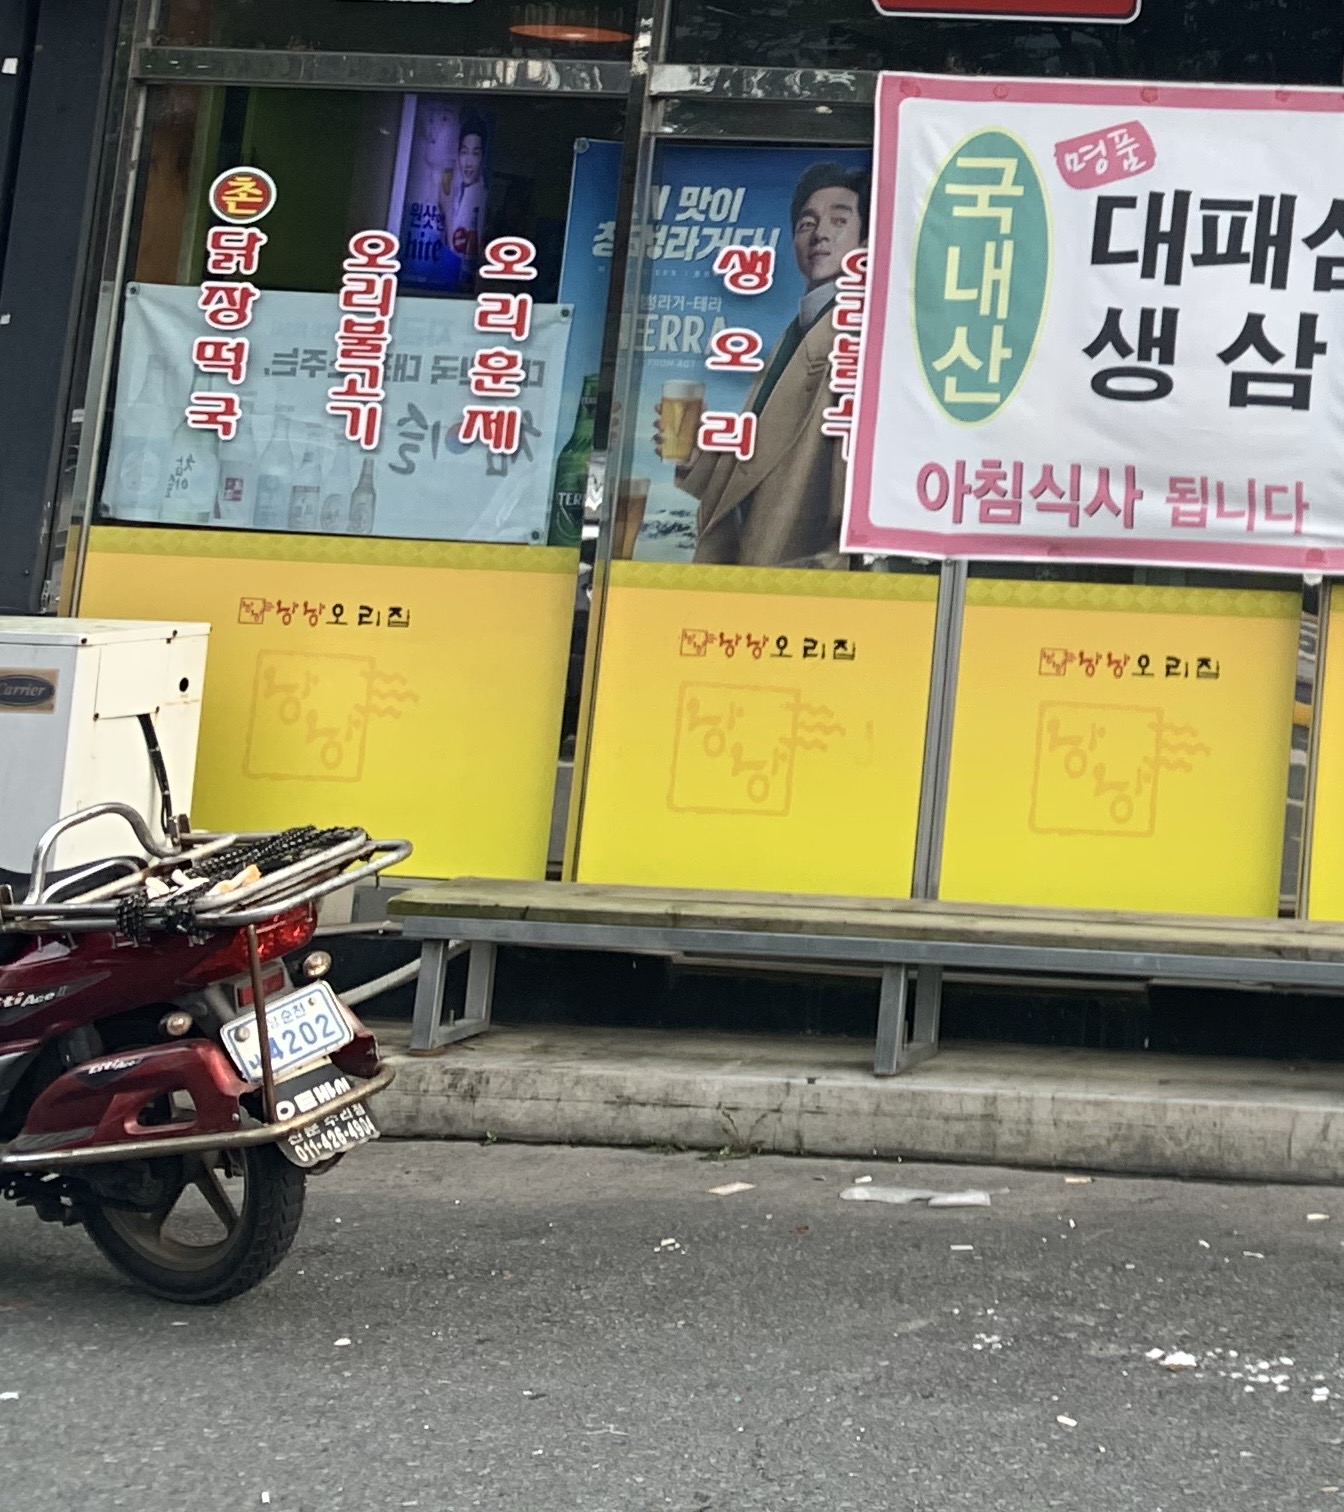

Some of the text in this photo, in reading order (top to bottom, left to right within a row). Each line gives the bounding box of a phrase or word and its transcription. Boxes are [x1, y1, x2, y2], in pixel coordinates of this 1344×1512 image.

[1062, 132, 1148, 181] 명품
[675, 185, 746, 223] 맛이
[937, 153, 1026, 409] 국내산
[327, 230, 401, 451] 오리불고기
[459, 234, 536, 454] 오리훈제
[916, 460, 1143, 531] 아침식사
[1165, 474, 1309, 537] 됩니다
[268, 1013, 337, 1061] 4202
